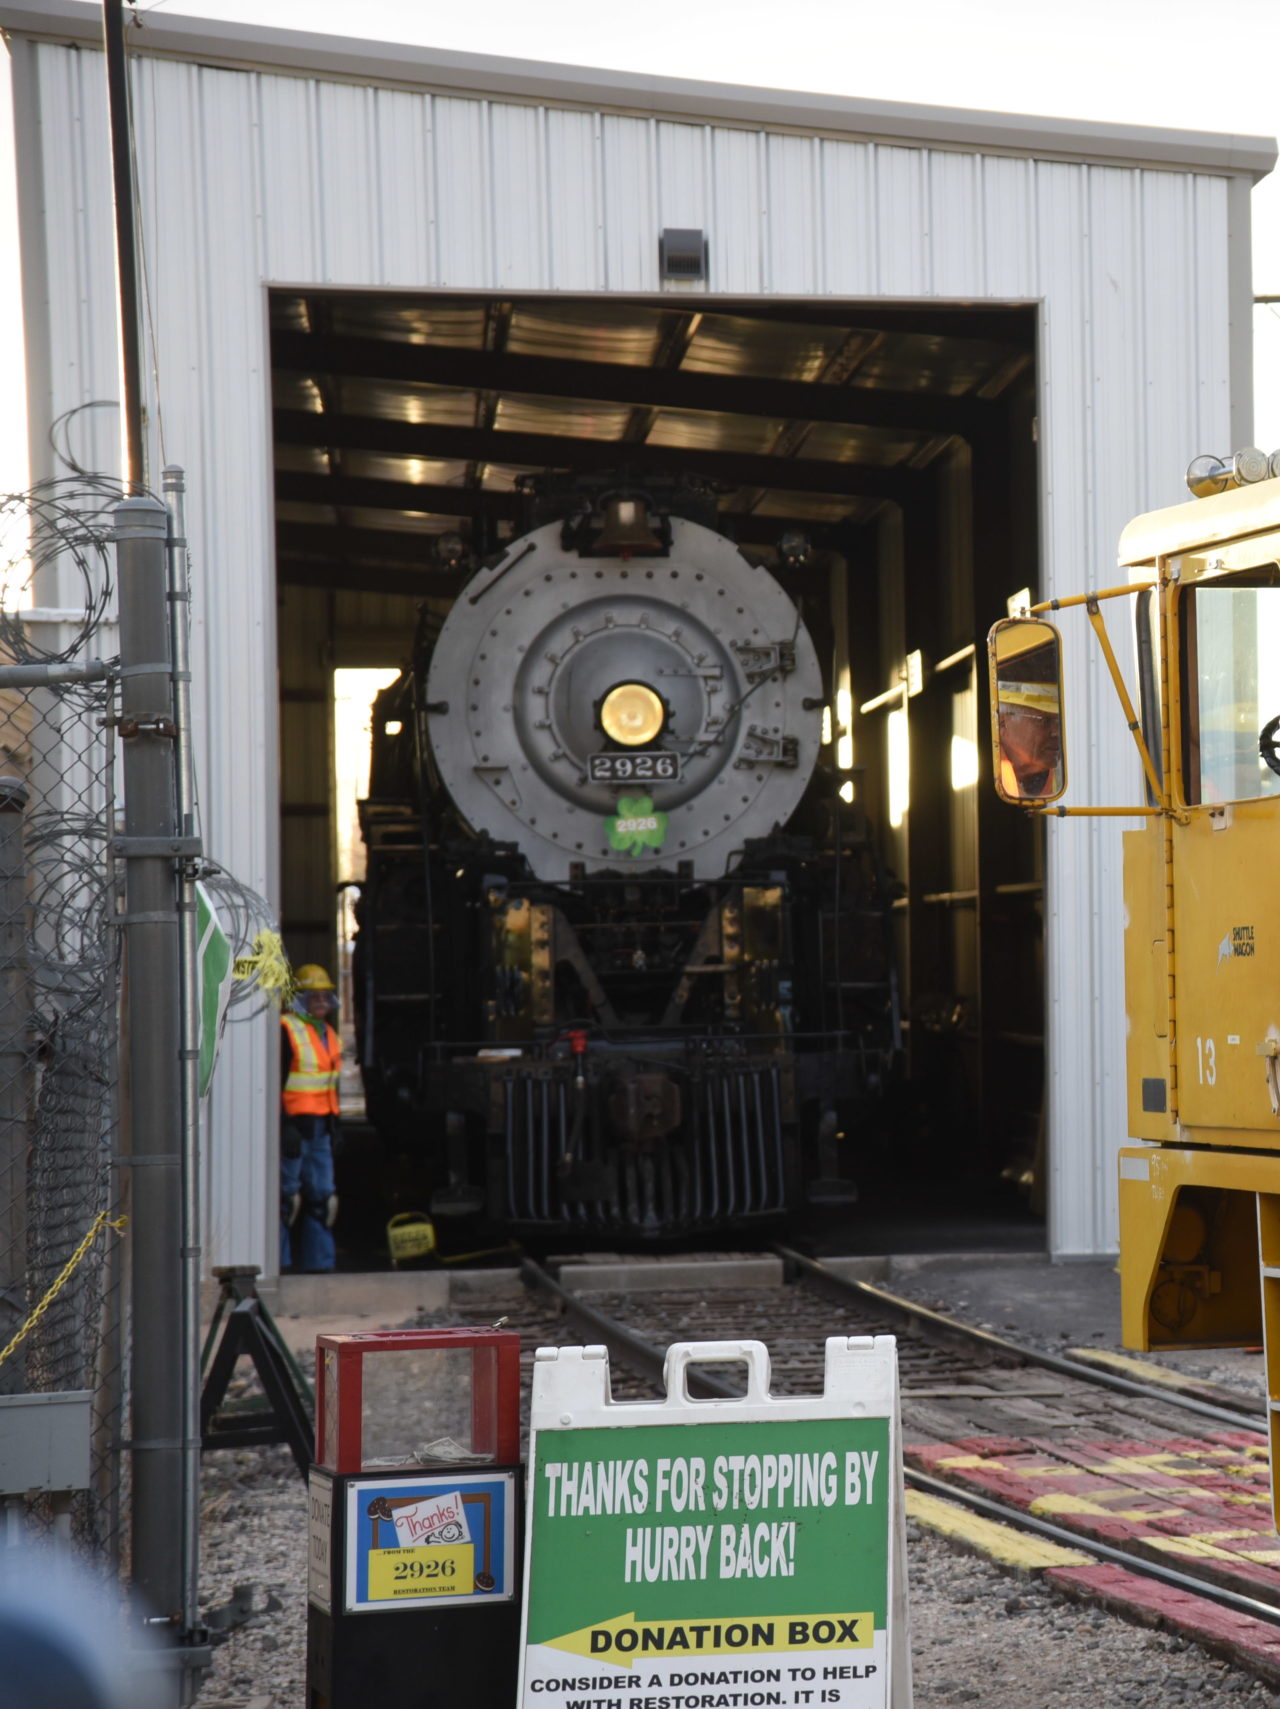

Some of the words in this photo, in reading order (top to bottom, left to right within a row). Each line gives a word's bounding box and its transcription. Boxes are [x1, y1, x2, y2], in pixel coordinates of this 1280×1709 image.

[594, 757, 673, 777] 2926
[616, 816, 658, 832] 2926
[1232, 926, 1254, 941] SHUTTLE
[1233, 942, 1255, 957] WAGON
[1196, 1037, 1217, 1086] 13
[544, 1458, 649, 1517] THANKS
[655, 1457, 706, 1513] FOR
[712, 1451, 838, 1511] STOPPING
[844, 1450, 879, 1506] BY
[394, 1494, 460, 1538] Thanks!
[624, 1525, 714, 1583] HURRY
[719, 1521, 796, 1579] BACK!
[393, 1559, 456, 1580] 2926
[393, 1586, 437, 1595] RESTORATION
[589, 1622, 775, 1654] DONATION
[787, 1619, 860, 1645] BOX
[530, 1675, 642, 1693] CONSIDER
[647, 1674, 663, 1688] A
[669, 1668, 781, 1687] DONATION
[787, 1667, 816, 1682] TO
[822, 1664, 878, 1680] HELP
[565, 1699, 622, 1709] WITH
[629, 1691, 787, 1709] RESTORATION.
[794, 1690, 815, 1704] IT
[821, 1689, 841, 1703] IS
